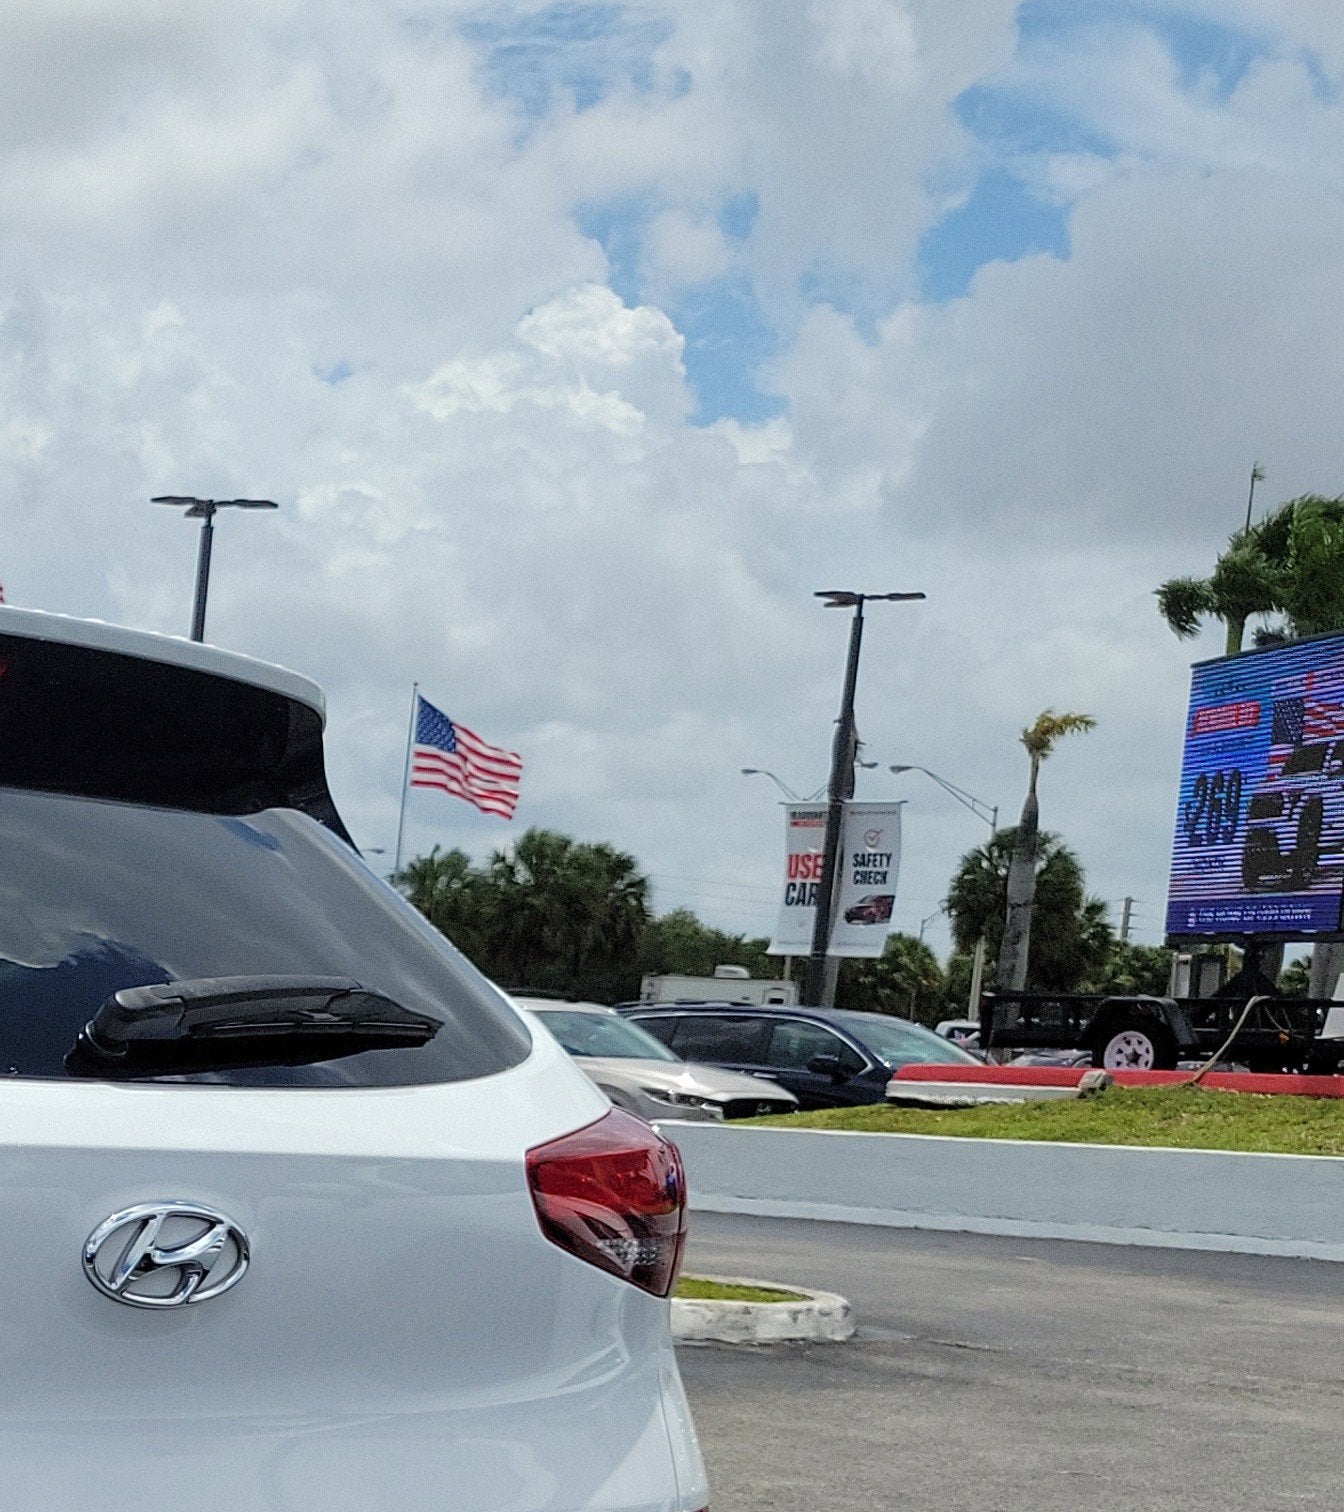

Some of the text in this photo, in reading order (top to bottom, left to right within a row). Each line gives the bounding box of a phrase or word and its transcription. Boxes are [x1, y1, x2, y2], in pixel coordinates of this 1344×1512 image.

[788, 853, 823, 879] USE
[853, 853, 892, 868] SAFETY
[853, 870, 888, 885] CHECK
[785, 882, 820, 907] CAR
